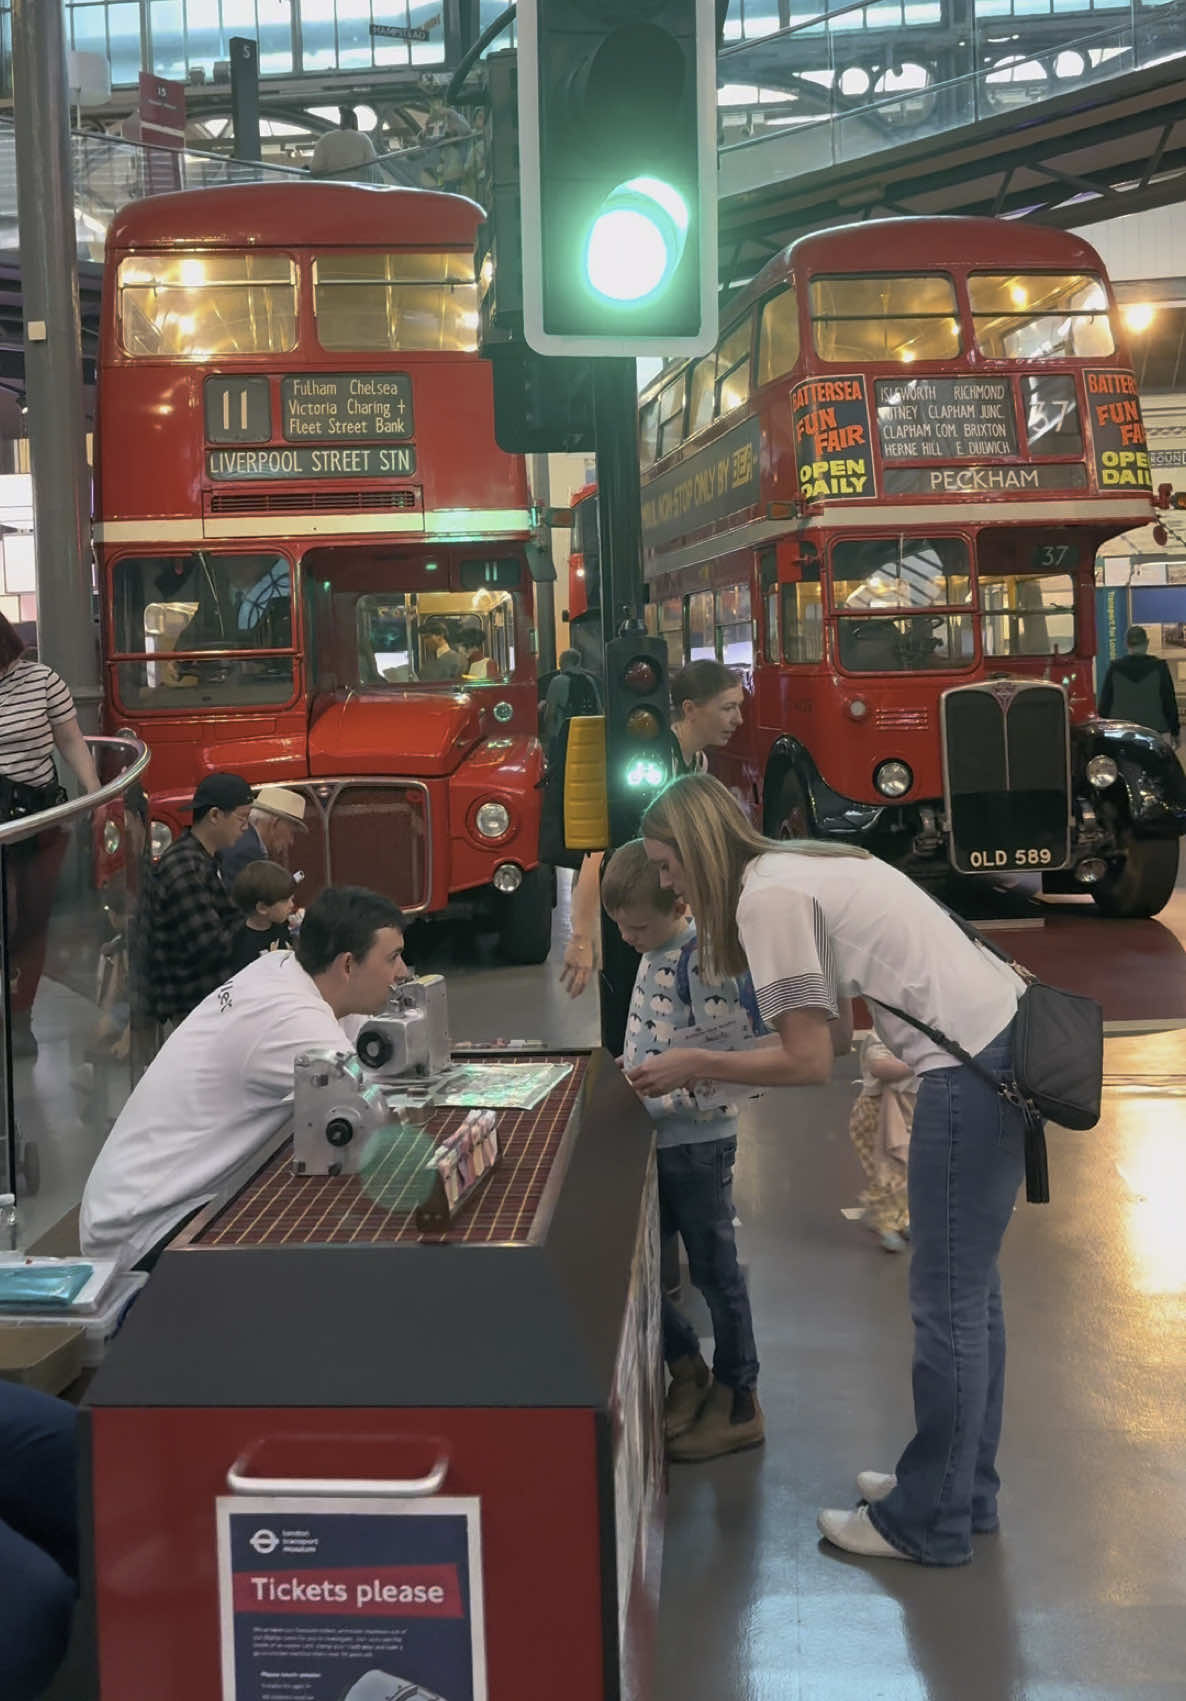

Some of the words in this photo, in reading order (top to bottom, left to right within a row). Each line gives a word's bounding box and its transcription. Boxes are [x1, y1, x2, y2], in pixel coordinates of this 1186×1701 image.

[293, 379, 337, 396] Fulham
[350, 379, 398, 396] Chelsea
[953, 384, 1005, 400] RICHMOND
[1088, 373, 1137, 394] BATTER
[223, 390, 248, 430] 11
[288, 399, 337, 416] Victoria
[347, 398, 391, 418] Charing
[880, 405, 918, 420] UTNEY
[928, 404, 976, 419] CLAPHAM
[1029, 400, 1069, 432] 37
[1096, 400, 1139, 427] FUN
[289, 418, 321, 435] Fleet
[328, 418, 368, 434] Street
[376, 417, 405, 433] Bank
[796, 407, 837, 442] FUN
[883, 424, 931, 440] CLAPHAM
[963, 422, 1007, 437] BRIXTON
[1120, 423, 1146, 447] FA
[814, 425, 866, 458] FAIR
[884, 441, 918, 457] HERNE
[921, 441, 943, 456] HILL
[968, 440, 1011, 455] DULWICH
[210, 450, 303, 474] LIVERPOOL
[311, 450, 371, 472] STREET
[379, 449, 410, 471] STN
[1102, 450, 1149, 468] OPE
[800, 459, 865, 483] OPEN
[930, 469, 1039, 490] PECKHAM
[1102, 469, 1152, 486] DAIL
[801, 475, 867, 498] DAILY
[1041, 544, 1069, 567] 37
[970, 849, 1008, 868] OLD
[1015, 848, 1052, 865] 589
[251, 1577, 348, 1602] Tickets
[356, 1579, 445, 1609] please
